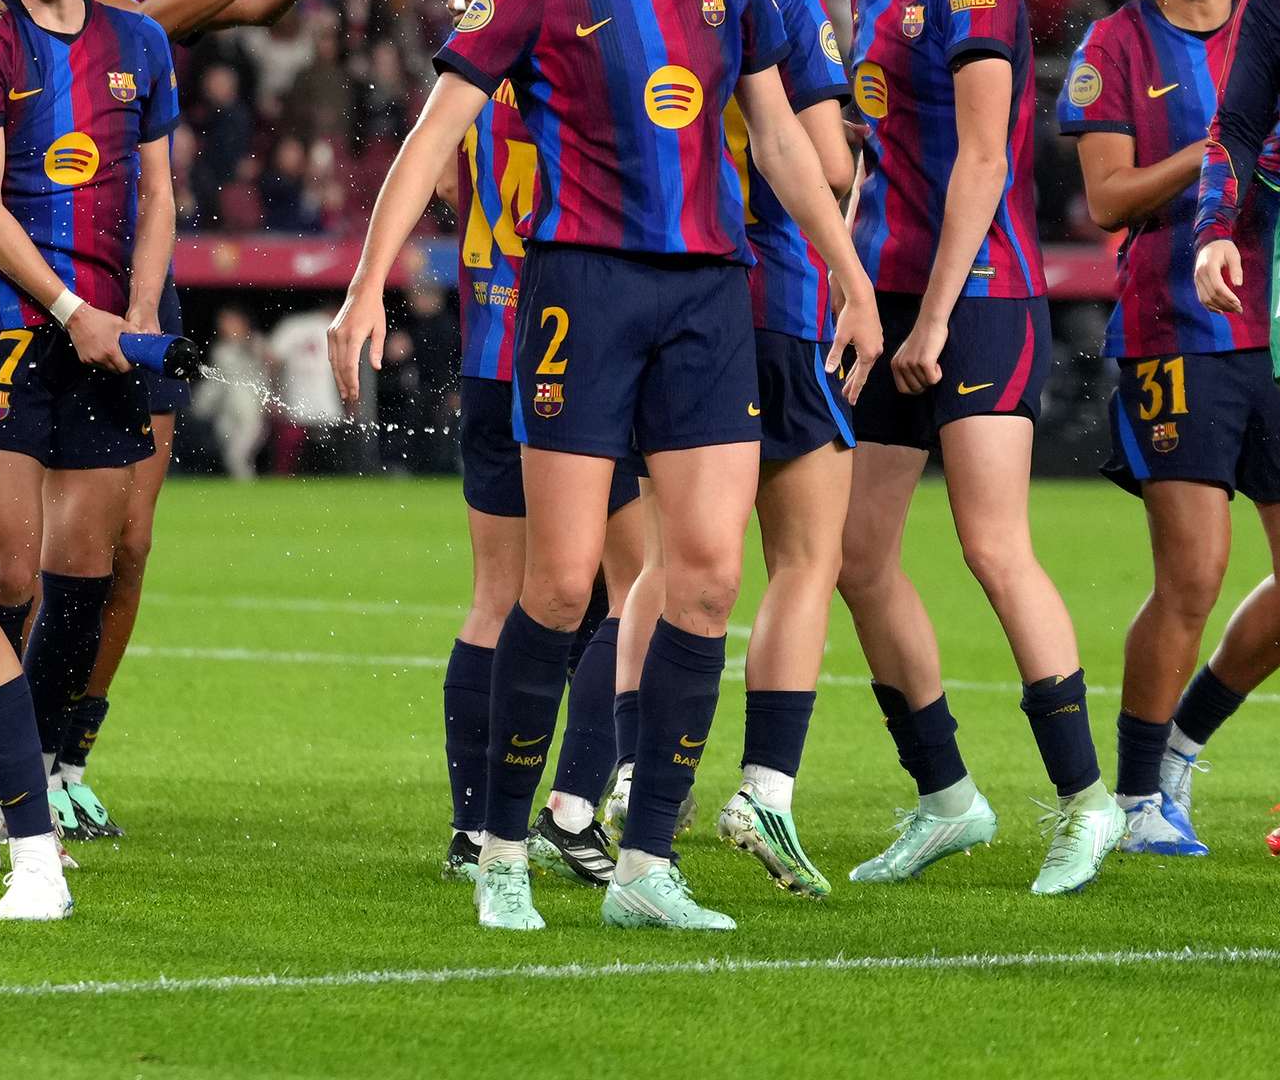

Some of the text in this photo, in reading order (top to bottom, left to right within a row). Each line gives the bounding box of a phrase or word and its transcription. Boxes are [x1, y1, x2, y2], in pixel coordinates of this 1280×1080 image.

[489, 295, 519, 308] FOUN
[535, 306, 570, 375] 2
[1136, 355, 1189, 421] 31
[504, 752, 543, 768] BARÇA
